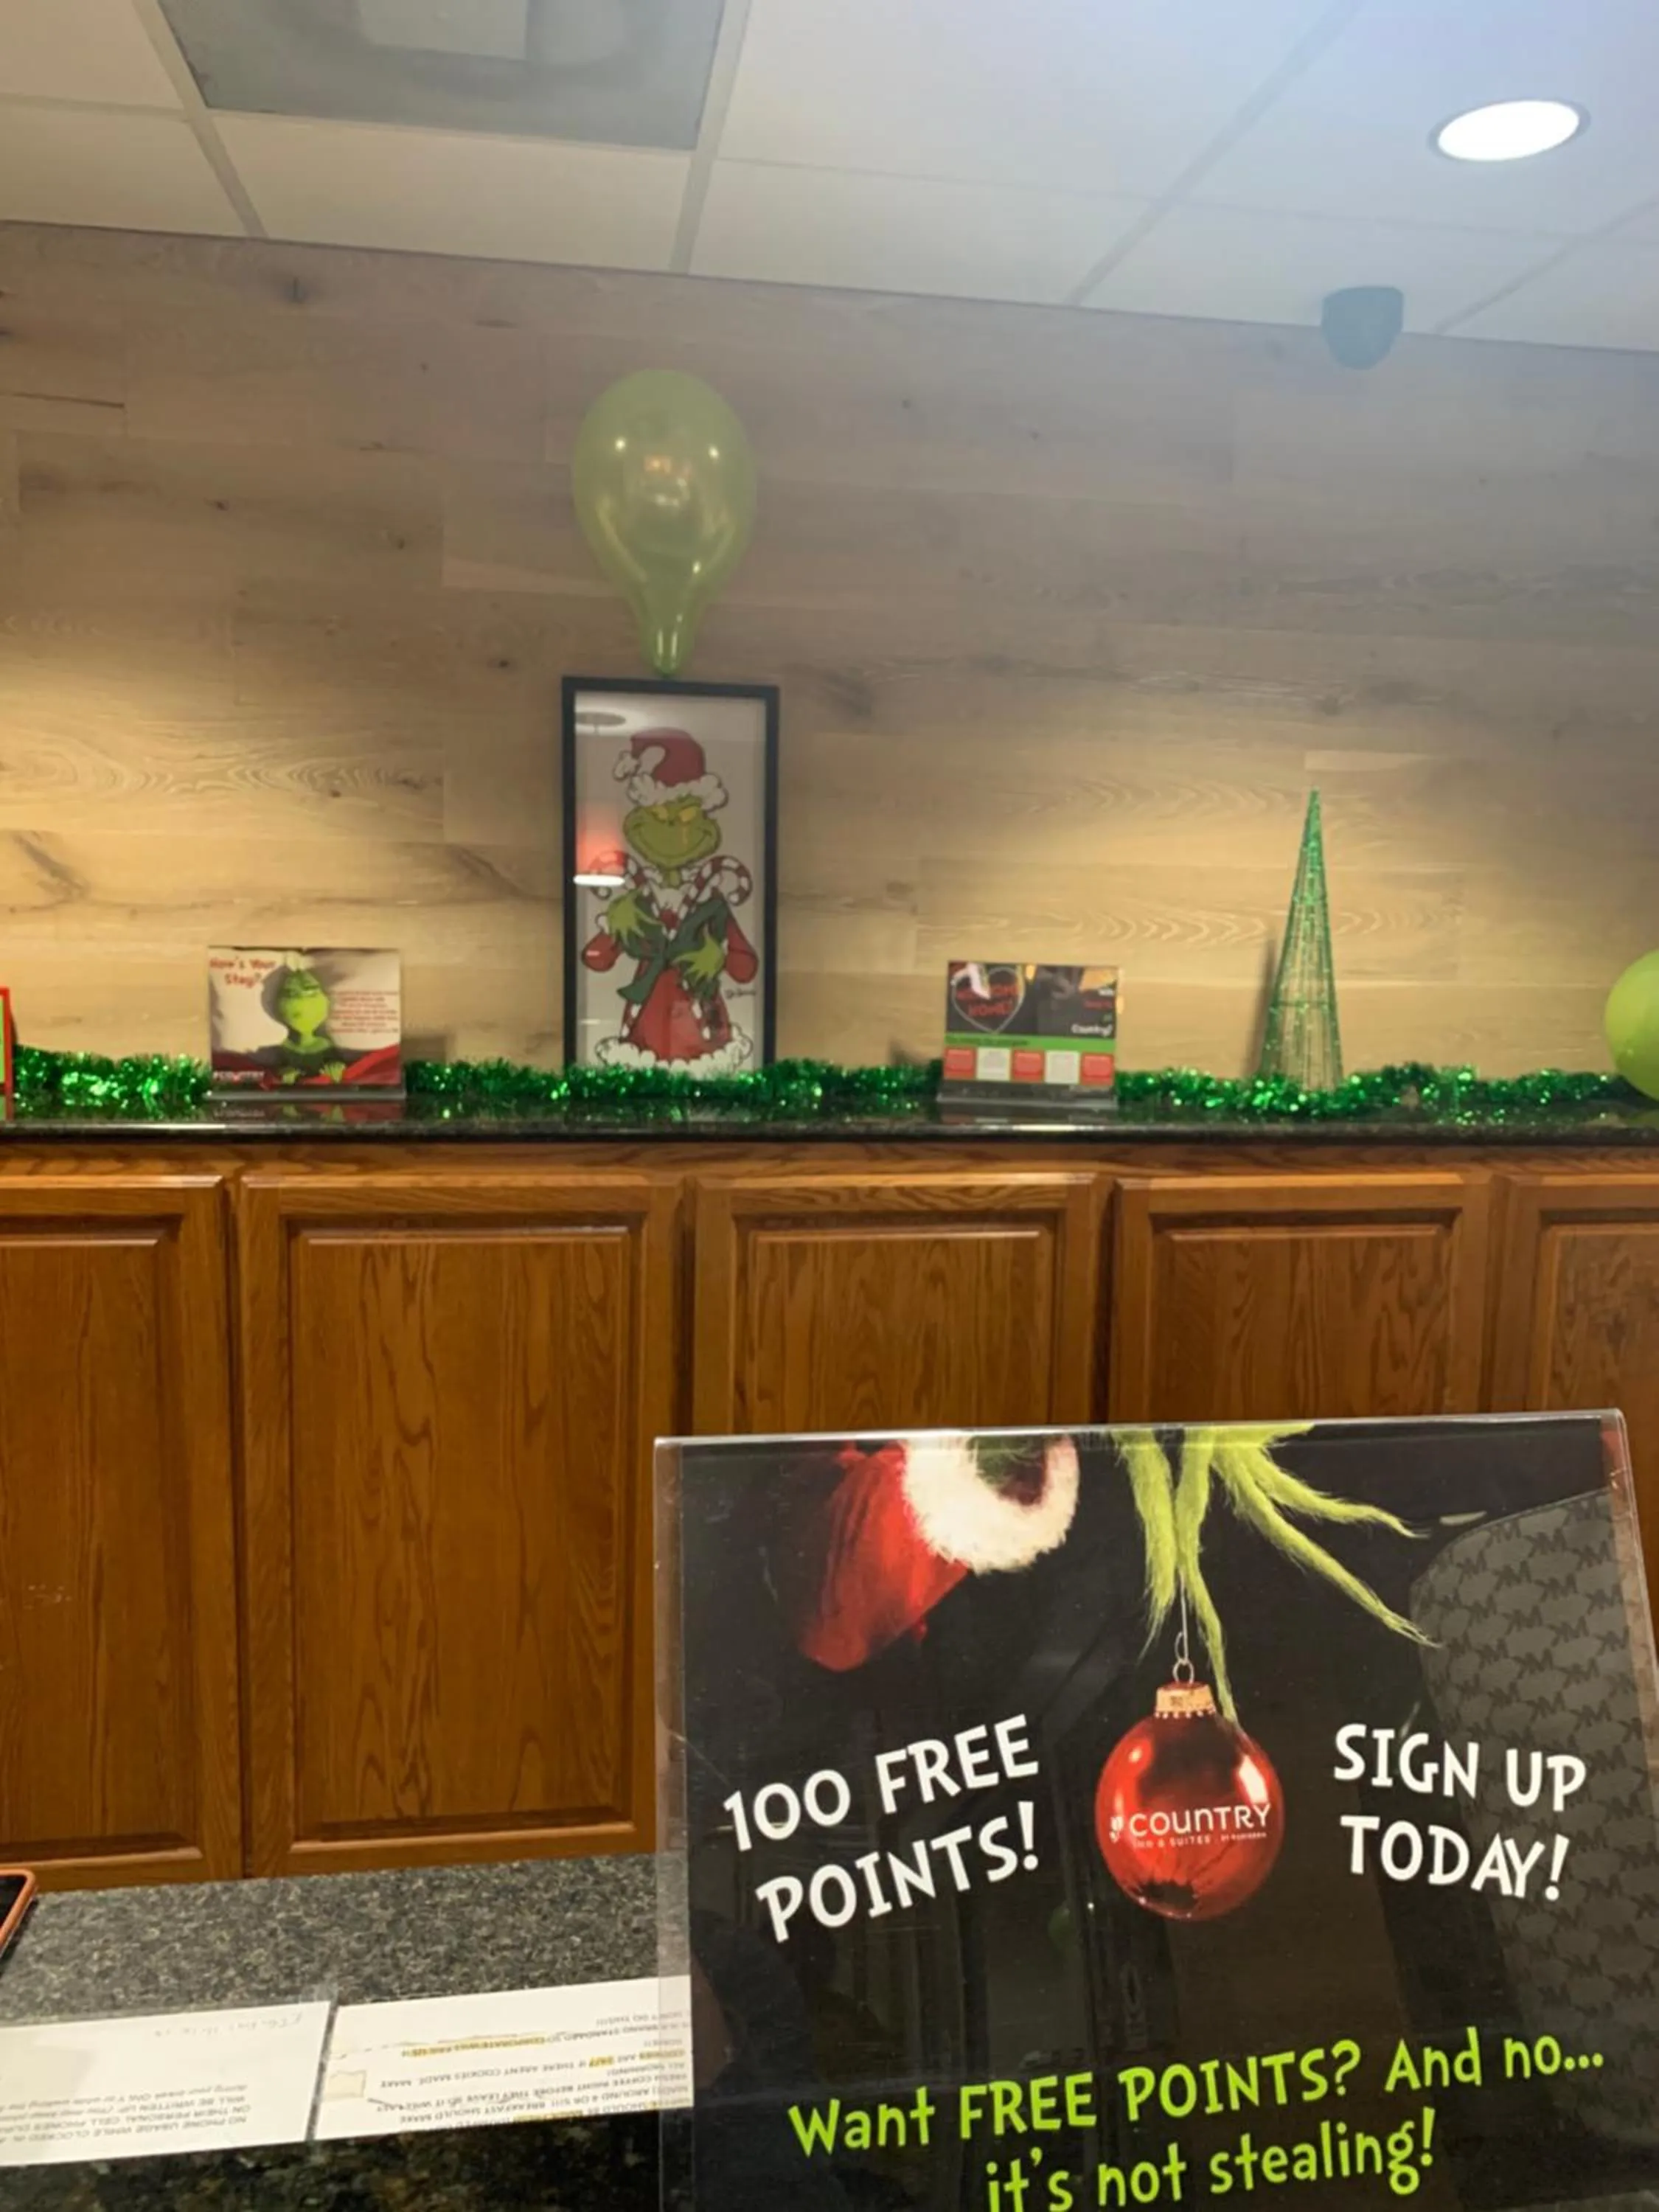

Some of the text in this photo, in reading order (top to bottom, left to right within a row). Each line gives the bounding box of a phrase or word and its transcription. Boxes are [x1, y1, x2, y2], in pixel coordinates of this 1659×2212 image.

[1334, 1723, 1587, 1812] SIGN UP
[723, 1714, 1039, 1851] 100 FREE
[1169, 1835, 1212, 1848] SUITES
[1340, 1815, 1570, 1902] TODAY!
[755, 1801, 1039, 1944] POINTS!
[563, 2029, 620, 2043] STANDARD
[482, 2036, 546, 2049] CORPORATE
[616, 2053, 636, 2063] ARE
[454, 2067, 501, 2080] COOKIES
[542, 2062, 574, 2073] THERE
[380, 2079, 412, 2089] MAKE
[577, 2080, 609, 2092] RIGHT
[611, 2074, 652, 2087] COFFEE
[501, 2090, 529, 2101] THEY
[532, 2085, 574, 2098] BEFORE
[601, 2088, 650, 2101] AROUND
[788, 2026, 1604, 2158] Want FREE POINTS? And no...
[198, 2098, 215, 2107] BE
[465, 2092, 500, 2104] LEAVE
[572, 2095, 590, 2105] OR
[139, 2100, 195, 2111] WRITTEN
[232, 2104, 251, 2114] ON
[483, 2101, 546, 2114] BREAKFAST
[125, 2111, 191, 2123] PERSONAL
[399, 2113, 432, 2124] MAKE
[434, 2107, 481, 2121] SHOULD
[33, 2121, 86, 2132] PHONES
[91, 2116, 120, 2126] CELL
[182, 2118, 226, 2129] PHONE
[94, 2126, 132, 2137] WHILE
[135, 2123, 179, 2134] USAGE
[28, 2129, 90, 2141] CLOCKED
[986, 2107, 1436, 2212] it's not stealing!
